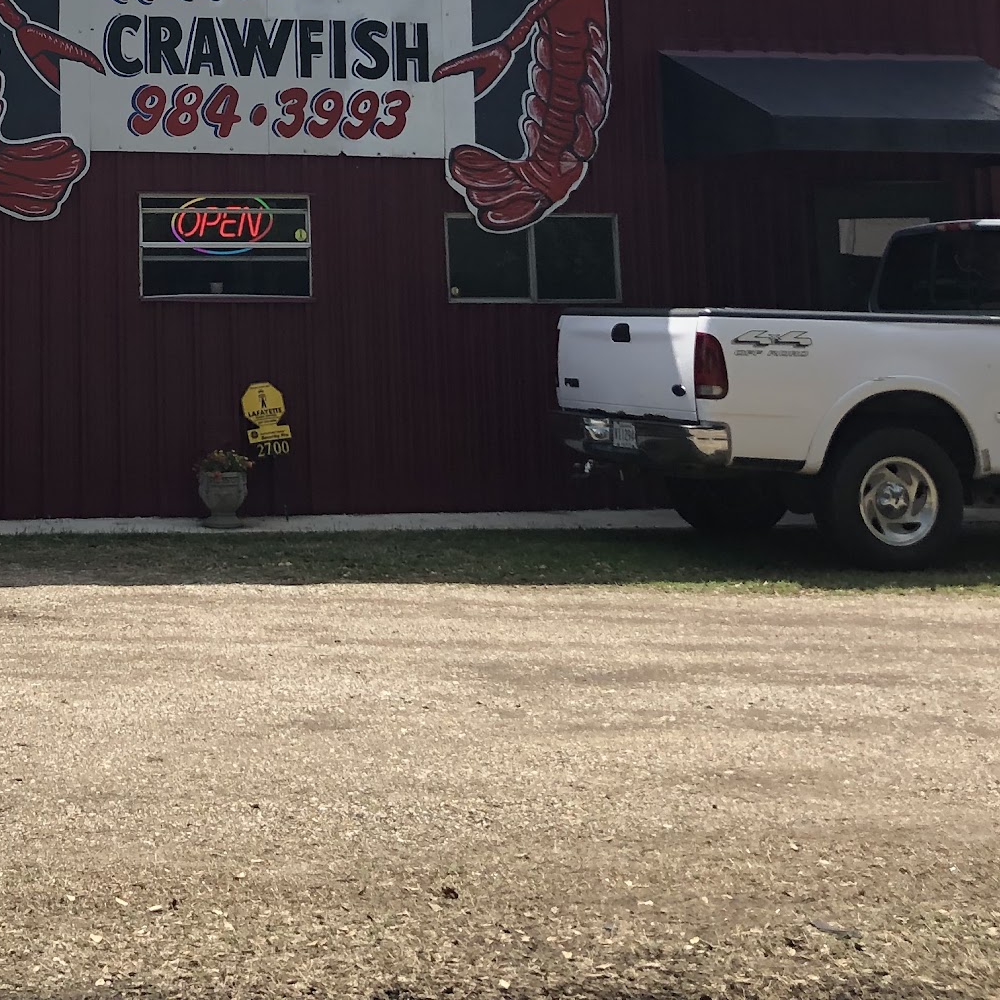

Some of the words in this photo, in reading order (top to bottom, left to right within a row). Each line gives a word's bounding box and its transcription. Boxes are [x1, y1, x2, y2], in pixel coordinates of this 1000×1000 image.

[103, 14, 430, 83] CRAWFISH
[177, 206, 263, 238] OPEN
[734, 349, 763, 357] OFF
[257, 440, 290, 457] 2700
